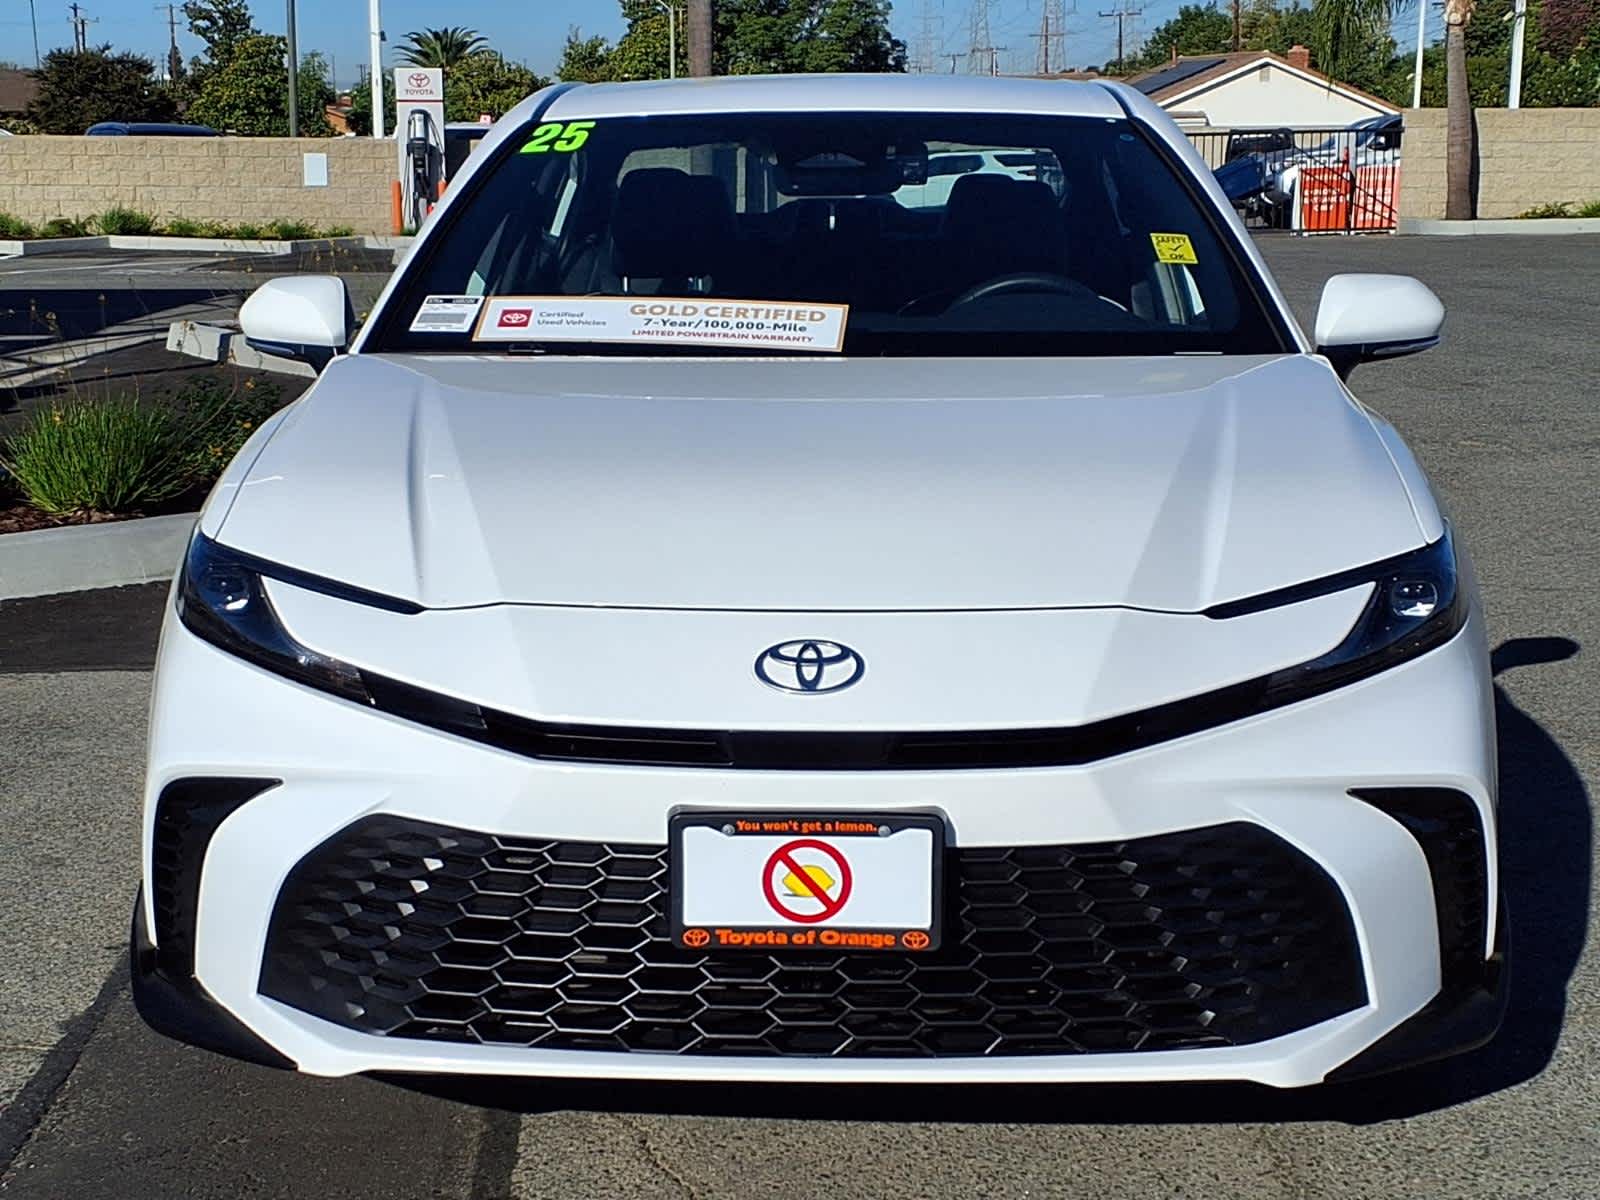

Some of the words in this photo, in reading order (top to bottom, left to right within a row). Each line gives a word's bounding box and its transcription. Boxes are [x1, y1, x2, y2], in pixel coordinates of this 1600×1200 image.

[520, 121, 596, 153] 25
[630, 304, 698, 317] GOLD
[704, 306, 826, 322] CERTIFIED
[643, 318, 807, 332] 7-Year/100,000-Mile
[632, 329, 675, 337] LIMITED
[677, 331, 749, 340] POWERTRAIN
[751, 333, 814, 342] WARRANTY
[736, 820, 761, 831] You
[764, 820, 800, 832] won't
[802, 821, 820, 833] get
[825, 824, 832, 832] a
[836, 821, 878, 833] lemon.
[715, 928, 788, 947] Toyota
[792, 930, 816, 945] of
[819, 930, 896, 947] Orange
